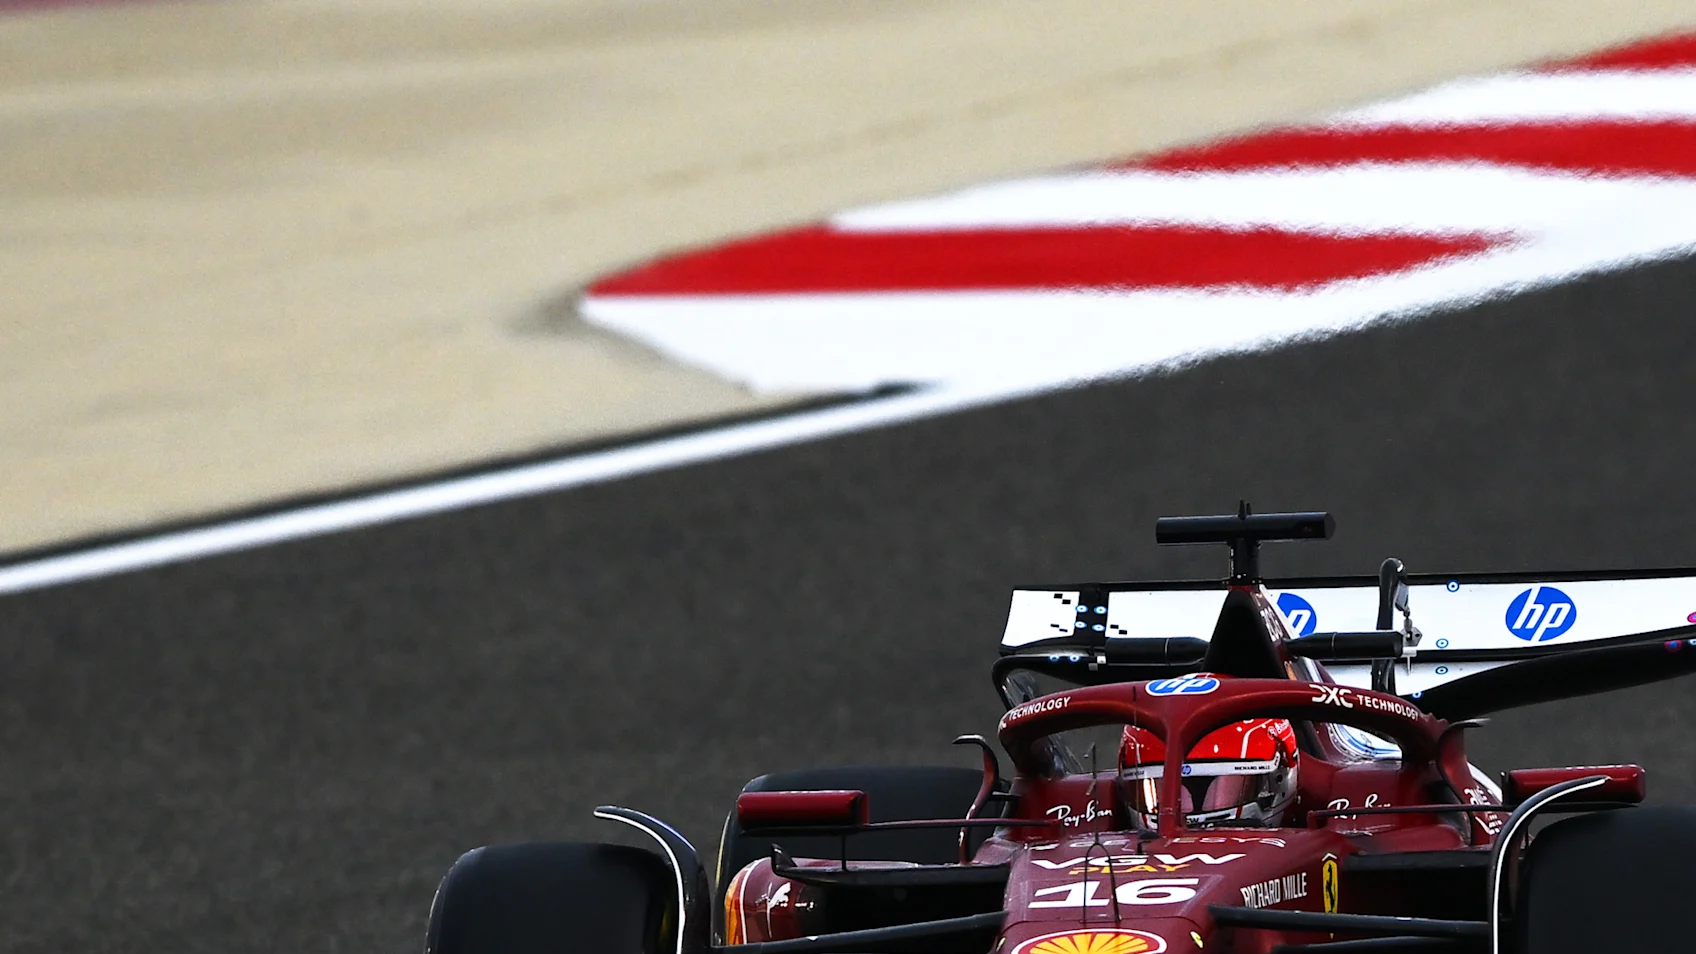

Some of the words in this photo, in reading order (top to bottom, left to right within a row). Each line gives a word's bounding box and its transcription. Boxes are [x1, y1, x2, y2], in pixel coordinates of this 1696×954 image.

[1509, 587, 1573, 641] hp
[1009, 697, 1070, 721] TECHNOLOGY
[1309, 684, 1354, 709] DXC
[1357, 694, 1419, 720] TECHNOLOGY
[1045, 800, 1113, 826] Ray-Ban
[1031, 854, 1247, 870] VGW
[1068, 864, 1194, 876] PLAY
[1028, 878, 1199, 909] 16
[1240, 879, 1281, 909] RICHARD
[1282, 872, 1307, 901] MILLE
